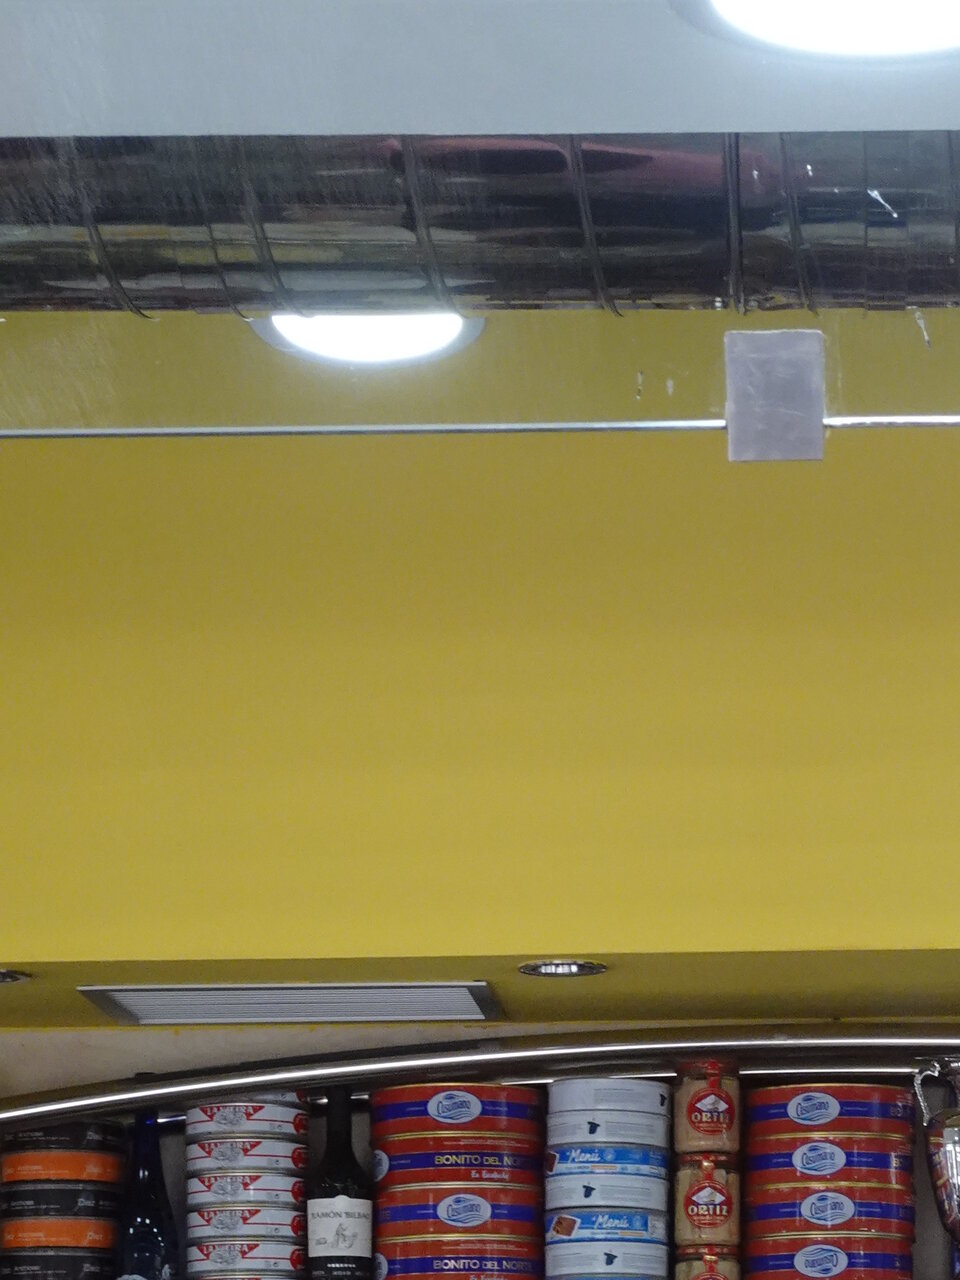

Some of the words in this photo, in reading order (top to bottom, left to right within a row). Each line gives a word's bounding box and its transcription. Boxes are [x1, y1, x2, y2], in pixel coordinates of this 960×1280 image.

[692, 1112, 729, 1123] ORTIZ
[435, 1155, 480, 1165] BONITO
[483, 1157, 502, 1165] DEL
[688, 1204, 728, 1215] ORTIZ
[433, 1260, 479, 1269] BONITO
[482, 1261, 500, 1269] DEL
